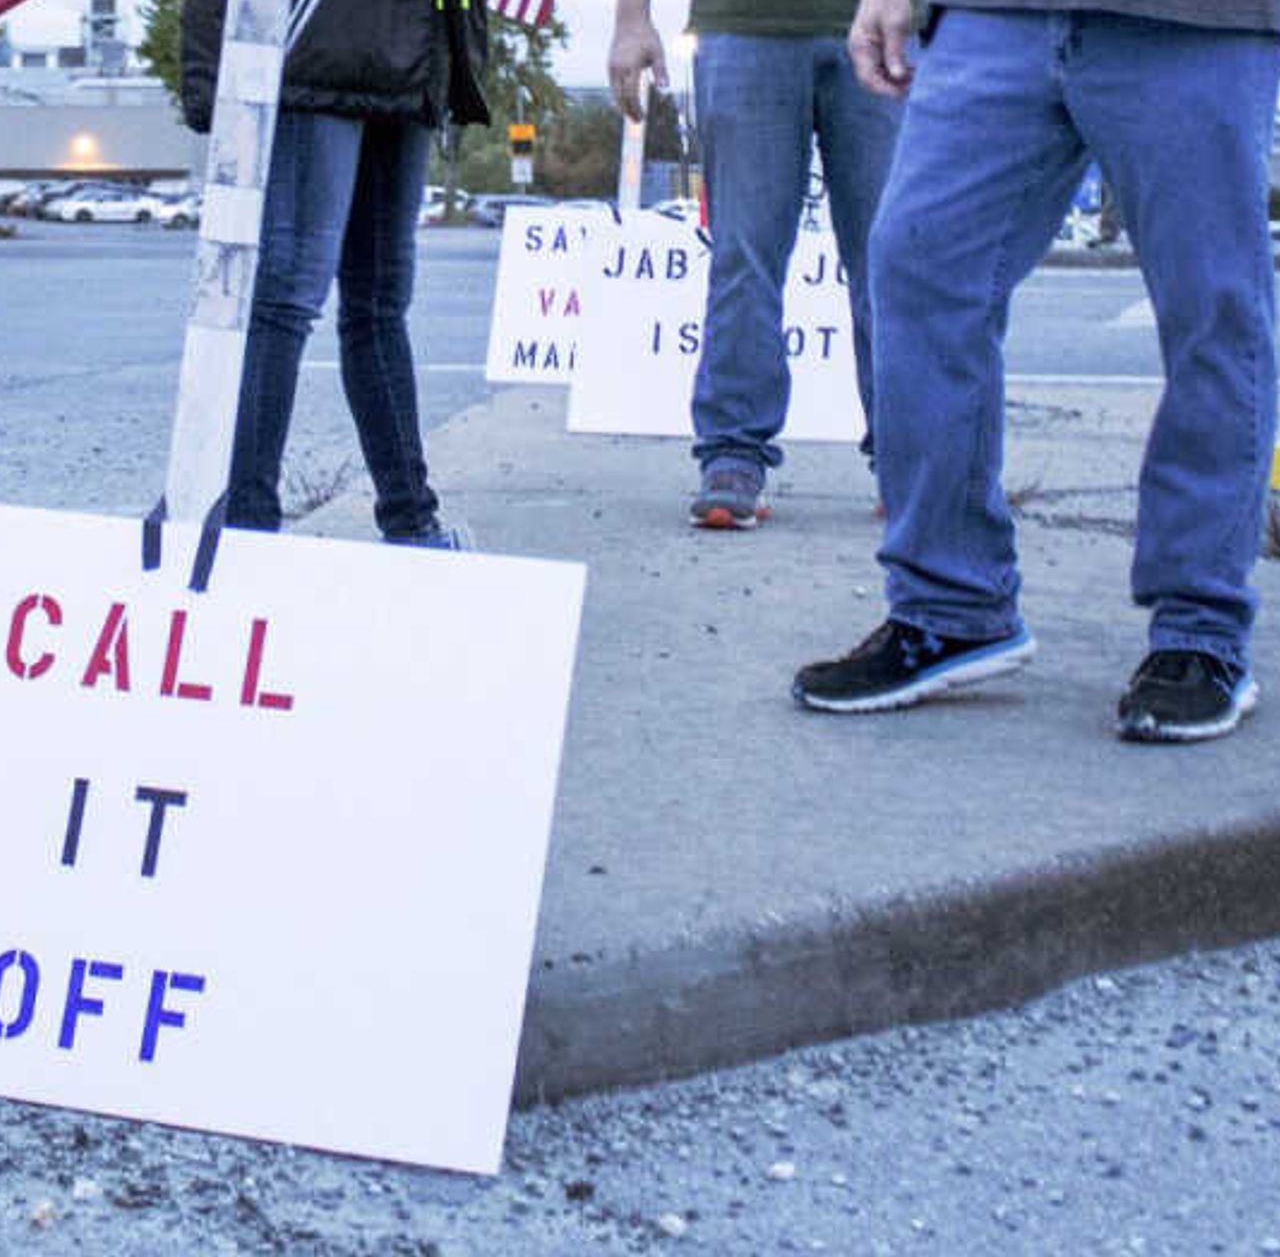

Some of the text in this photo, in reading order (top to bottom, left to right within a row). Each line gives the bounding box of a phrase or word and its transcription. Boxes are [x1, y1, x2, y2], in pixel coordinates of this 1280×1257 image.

[602, 247, 688, 280] JAB
[652, 321, 700, 355] IS
[5, 593, 295, 712] CALL
[60, 777, 188, 878] IT
